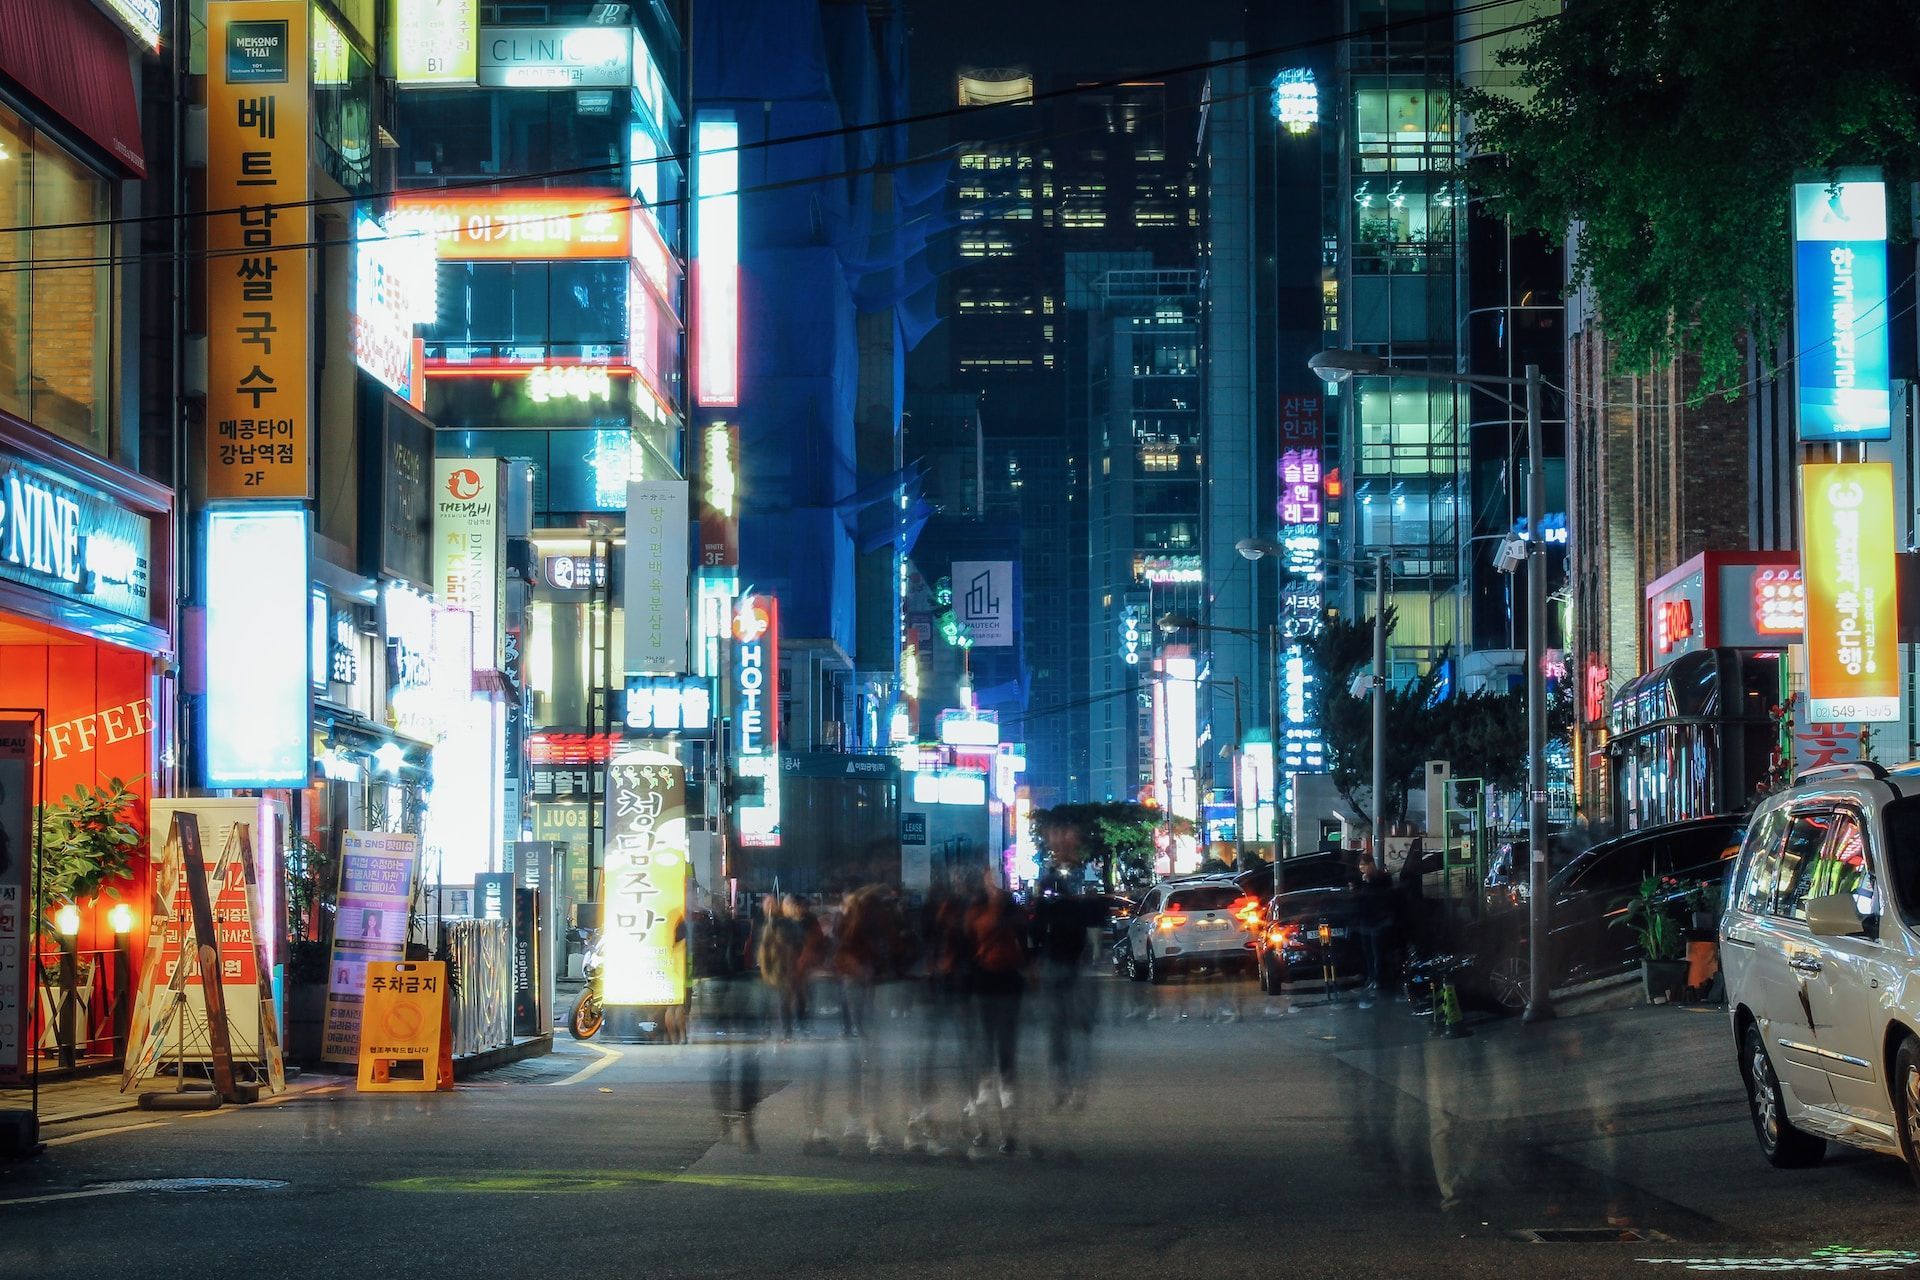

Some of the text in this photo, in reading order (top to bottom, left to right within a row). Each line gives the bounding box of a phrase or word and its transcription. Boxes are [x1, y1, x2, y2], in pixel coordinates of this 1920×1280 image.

[236, 37, 278, 47] MEKONG
[245, 47, 270, 57] THAI
[428, 58, 443, 72] B1
[236, 96, 278, 409] 베트남쌀국수
[219, 418, 294, 440] 메콩타이
[219, 444, 294, 465] 강남역점
[244, 472, 265, 487] 2F
[1284, 463, 1320, 483] 슬림
[1284, 503, 1320, 524] 레그
[9, 477, 80, 584] NINE
[705, 551, 725, 565] 3F
[1285, 594, 1321, 611] 시크릿
[741, 645, 763, 755] HOTEL
[781, 757, 801, 770] 공사
[364, 839, 385, 849] SNS
[616, 789, 666, 943] 청담주막
[519, 941, 528, 990] Spaghetti
[371, 976, 437, 993] 주차금지
